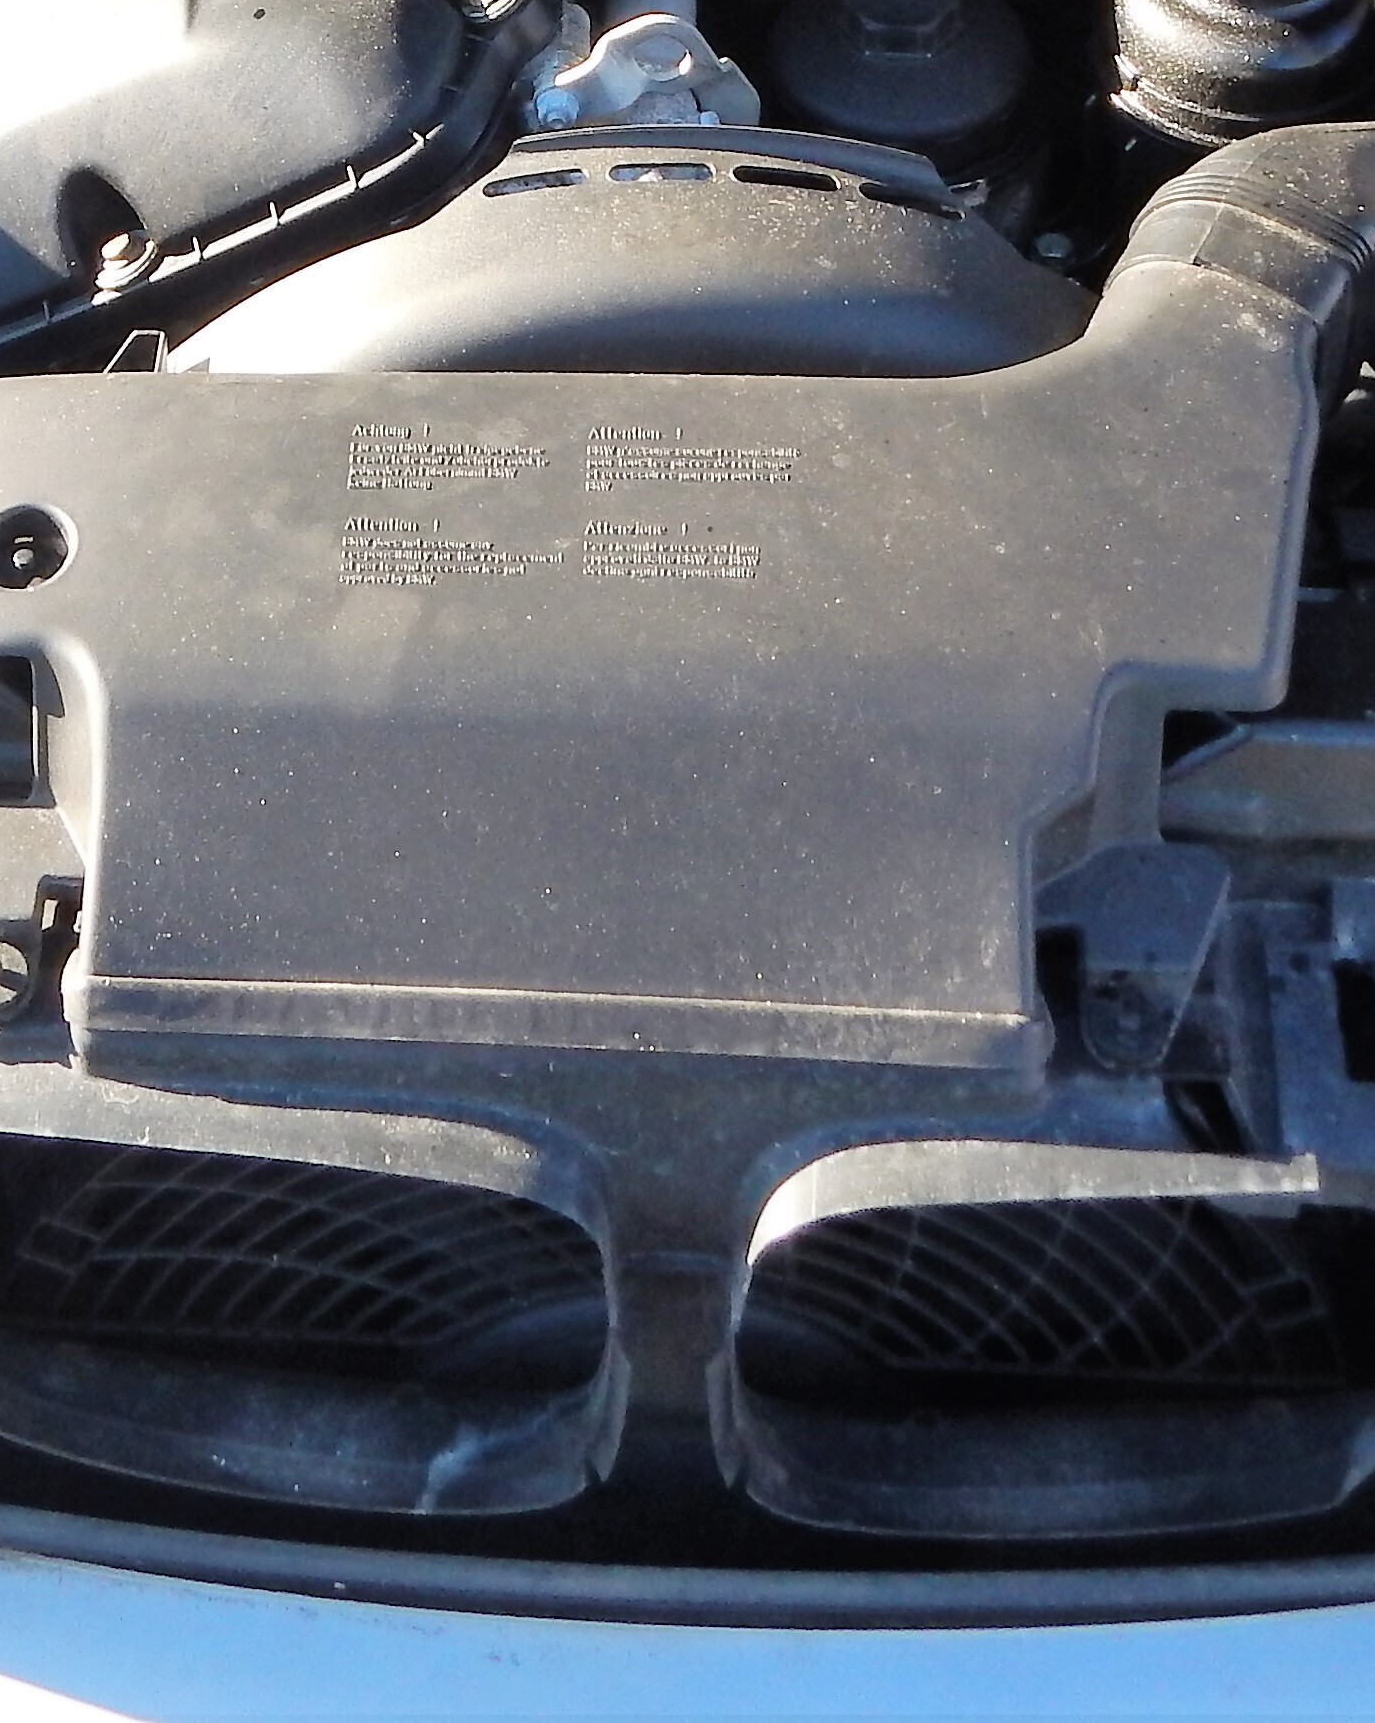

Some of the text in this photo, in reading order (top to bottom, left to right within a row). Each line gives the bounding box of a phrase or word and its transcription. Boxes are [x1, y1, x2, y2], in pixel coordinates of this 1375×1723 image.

[352, 423, 412, 439] Achtung
[588, 426, 662, 440] Attention
[344, 516, 420, 532] Attention
[584, 520, 668, 536] Attenzione
